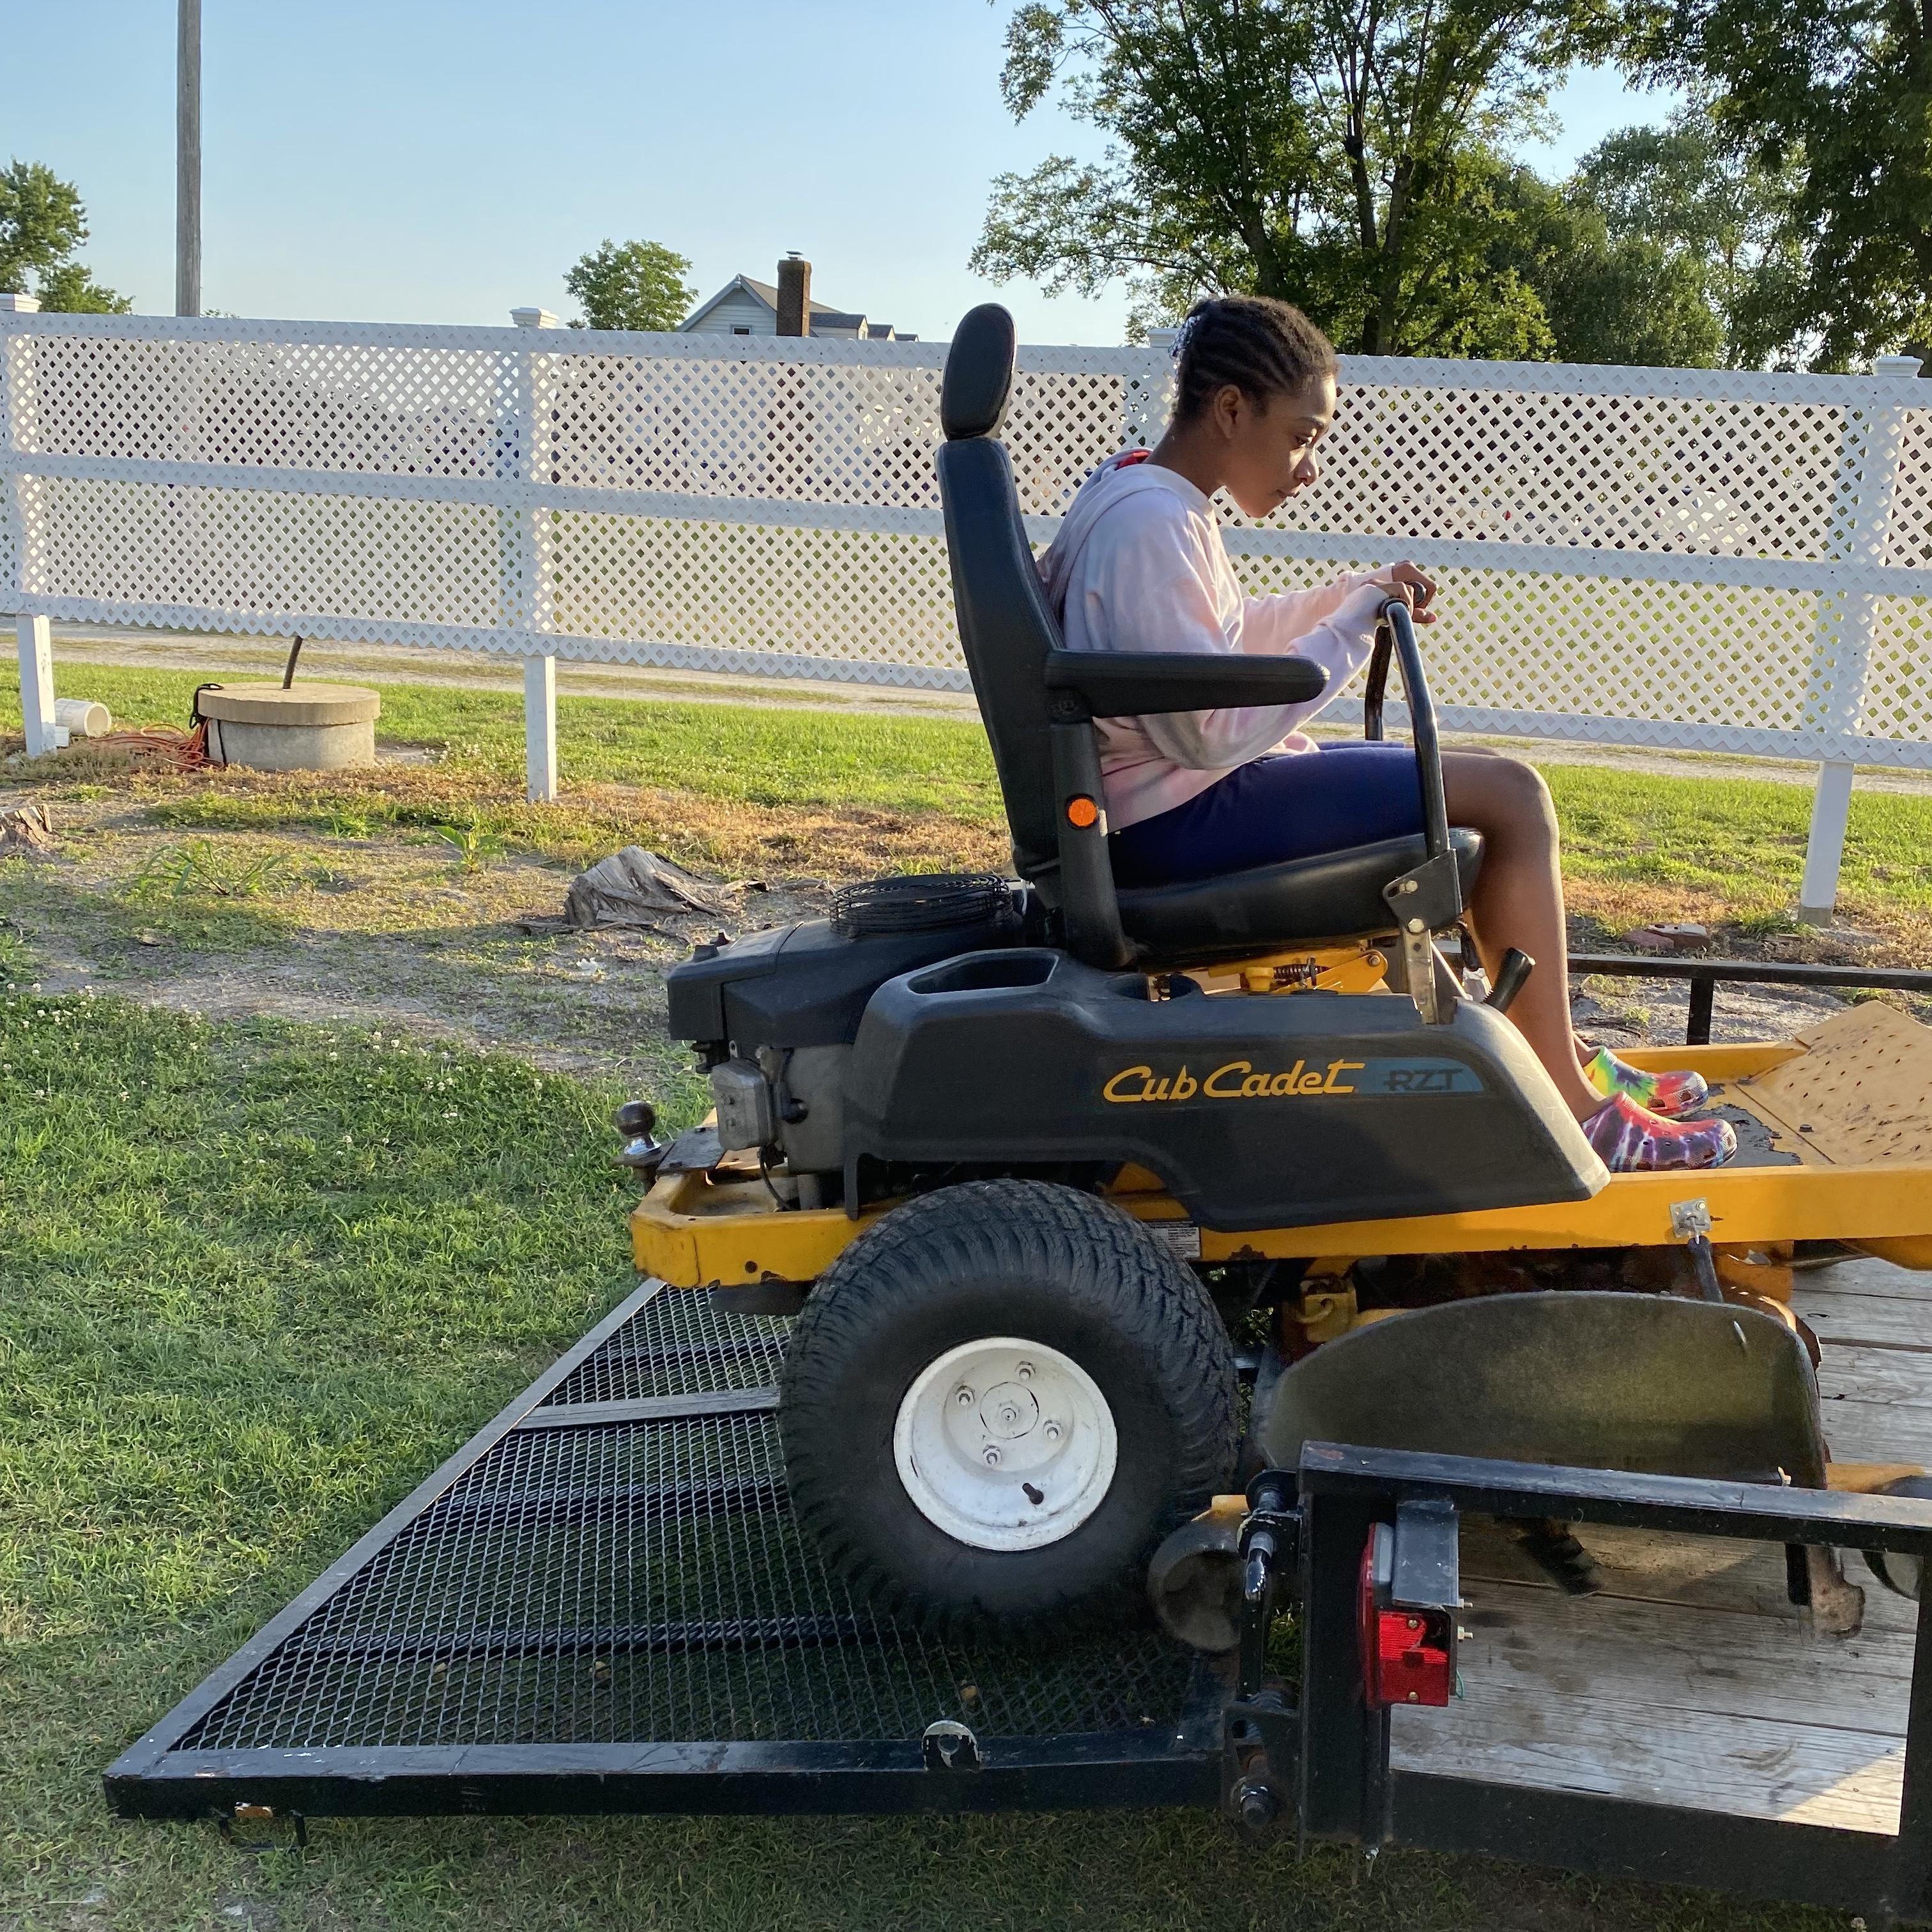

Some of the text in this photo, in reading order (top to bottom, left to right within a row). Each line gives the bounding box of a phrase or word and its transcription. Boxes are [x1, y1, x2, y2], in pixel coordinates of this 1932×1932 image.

[1103, 1059, 1464, 1102] Cub Cadet RZT
